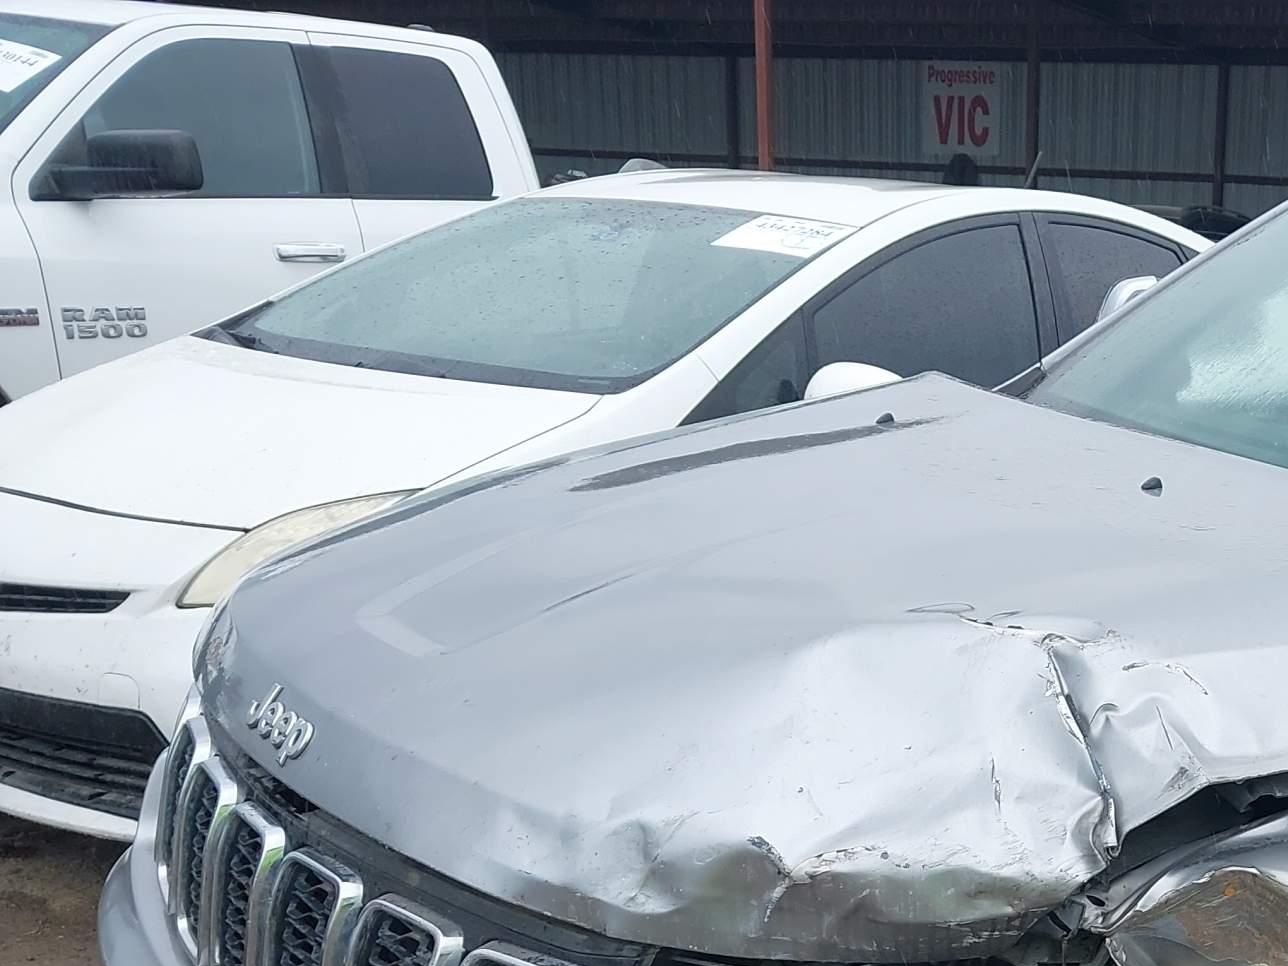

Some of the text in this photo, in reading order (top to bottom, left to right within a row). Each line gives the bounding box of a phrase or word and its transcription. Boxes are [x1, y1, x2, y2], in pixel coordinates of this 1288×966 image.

[927, 65, 995, 88] Progressive
[933, 94, 990, 147] VIC
[61, 307, 146, 322] RAM
[63, 323, 148, 340] 1500
[247, 682, 315, 768] Jeep
